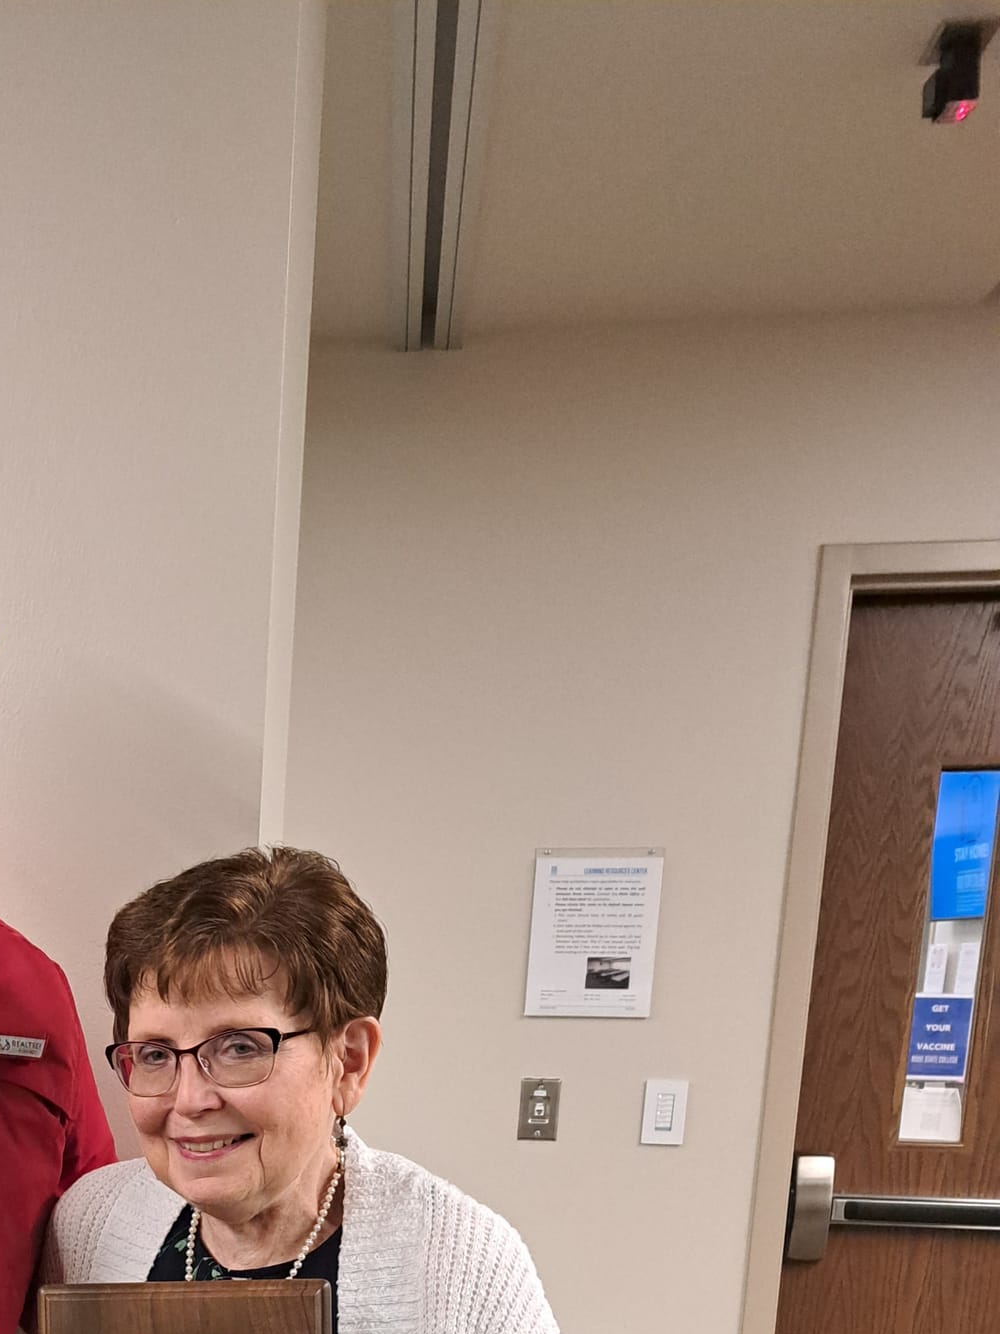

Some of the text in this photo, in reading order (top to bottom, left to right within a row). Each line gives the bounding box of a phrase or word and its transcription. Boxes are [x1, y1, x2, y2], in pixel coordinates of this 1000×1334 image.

[931, 1004, 950, 1013] GET
[926, 1024, 951, 1032] YOUR
[916, 1043, 956, 1052] VACCINE
